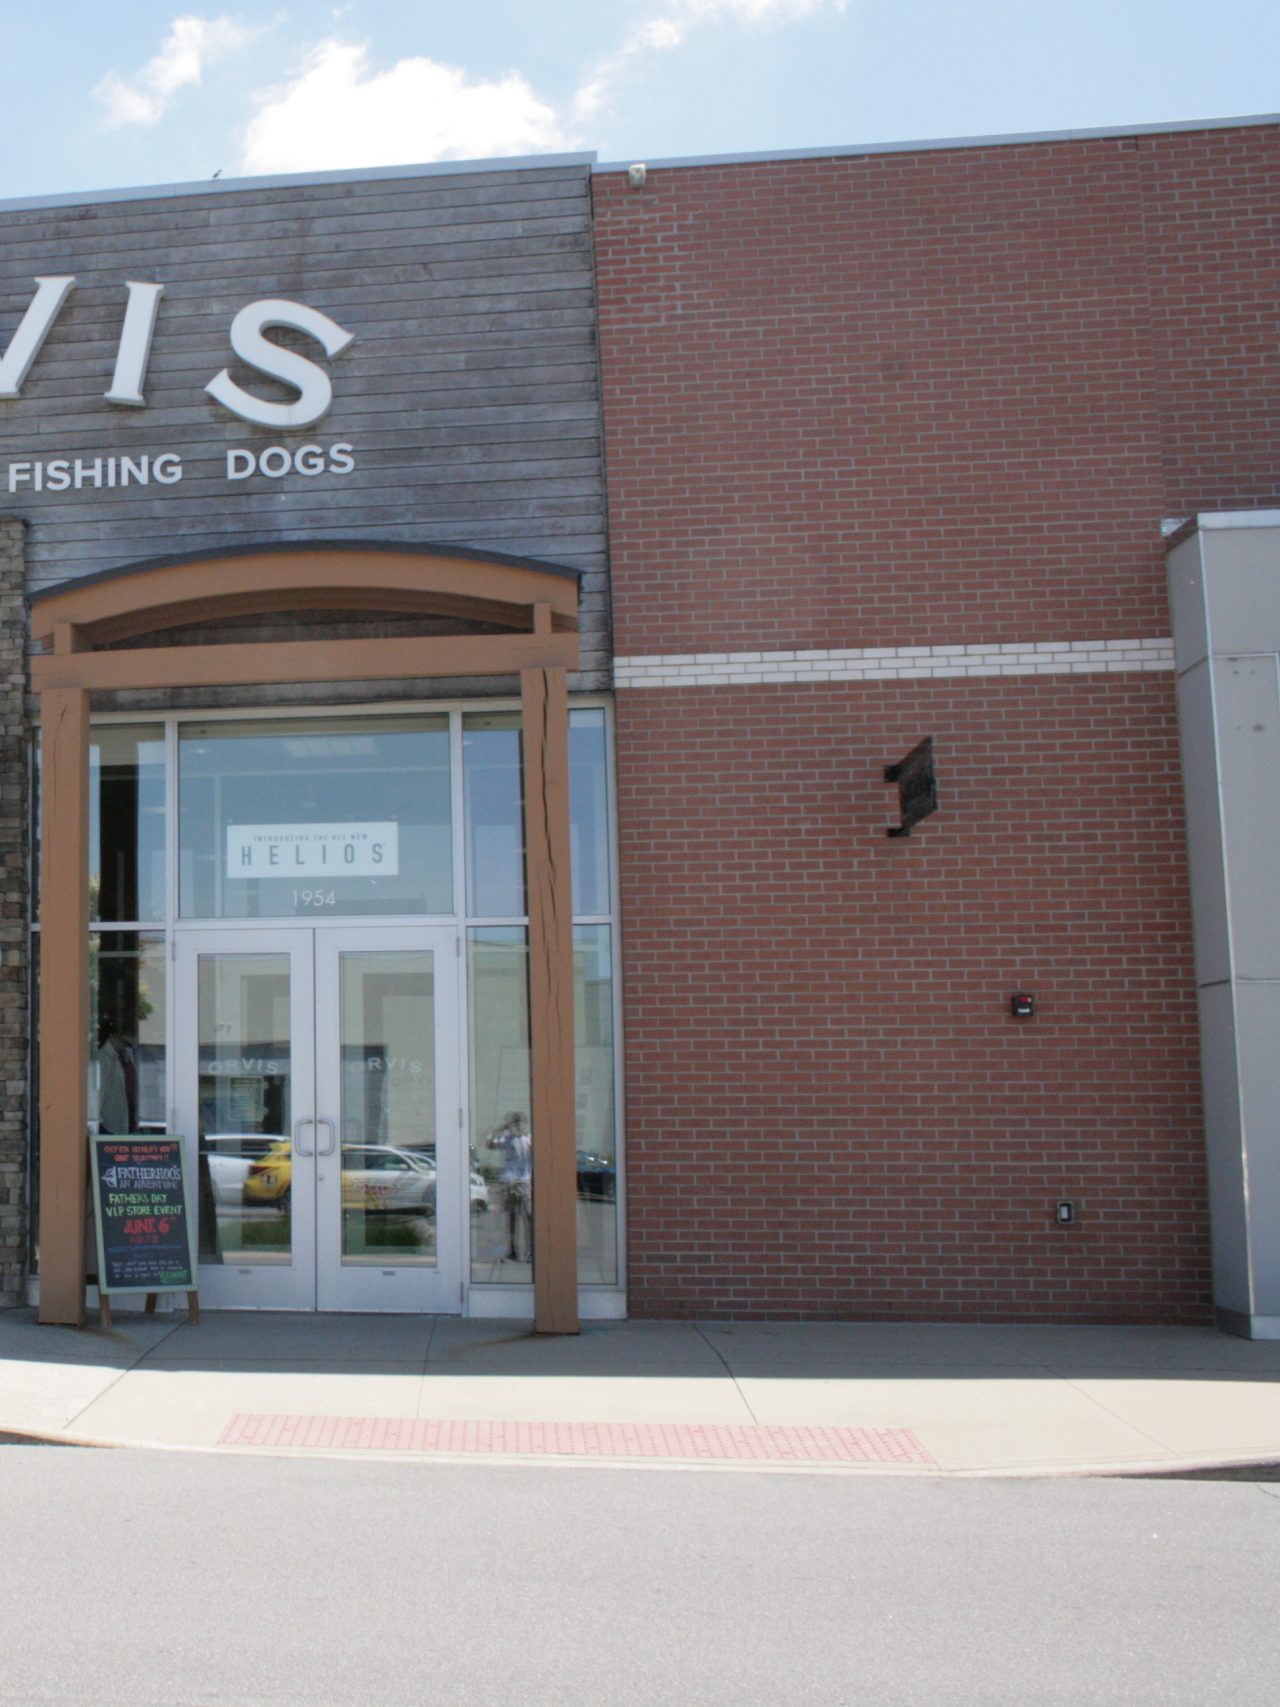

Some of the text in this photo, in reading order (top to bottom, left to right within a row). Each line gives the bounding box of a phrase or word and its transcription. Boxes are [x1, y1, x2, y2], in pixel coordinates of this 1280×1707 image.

[8, 453, 183, 493] FISHING
[226, 443, 355, 480] DOGS
[331, 833, 347, 841] ALL
[241, 843, 384, 866] HELIOS
[292, 890, 336, 907] 1954
[207, 1057, 280, 1075] ORVIS
[350, 1057, 424, 1074] ORVIS
[151, 1193, 168, 1204] DAY
[126, 1206, 152, 1216] STORE
[153, 1205, 183, 1215] EVENT
[123, 1218, 157, 1235] JUNE
